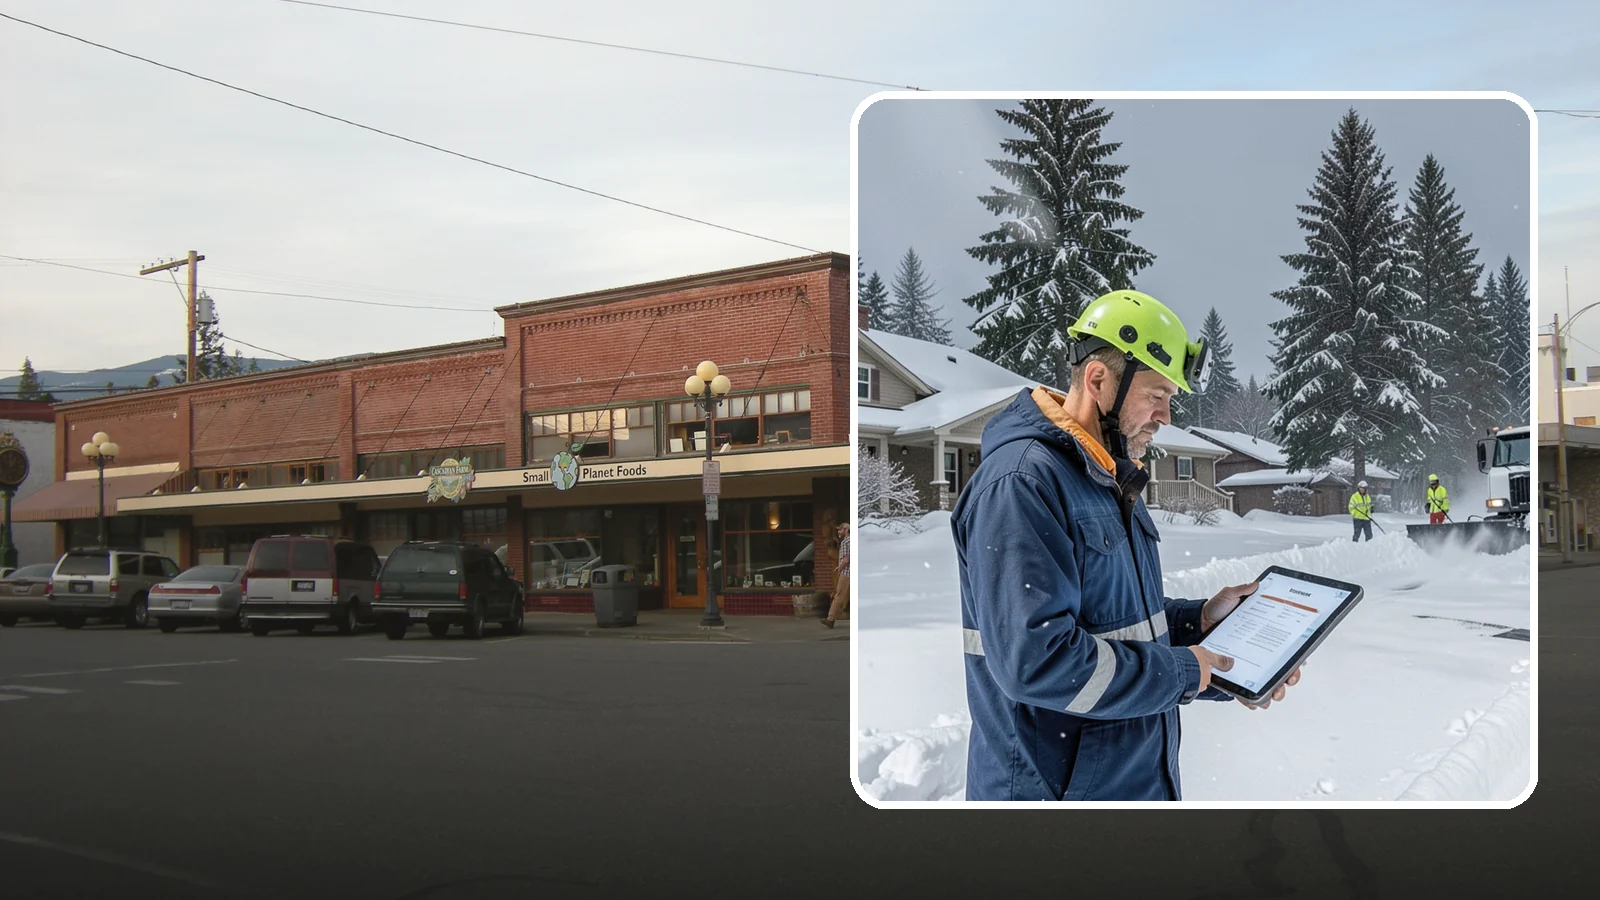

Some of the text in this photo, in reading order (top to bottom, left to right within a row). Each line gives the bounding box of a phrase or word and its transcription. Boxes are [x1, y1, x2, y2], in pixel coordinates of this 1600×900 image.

[523, 464, 647, 483] Small Planet Foods
